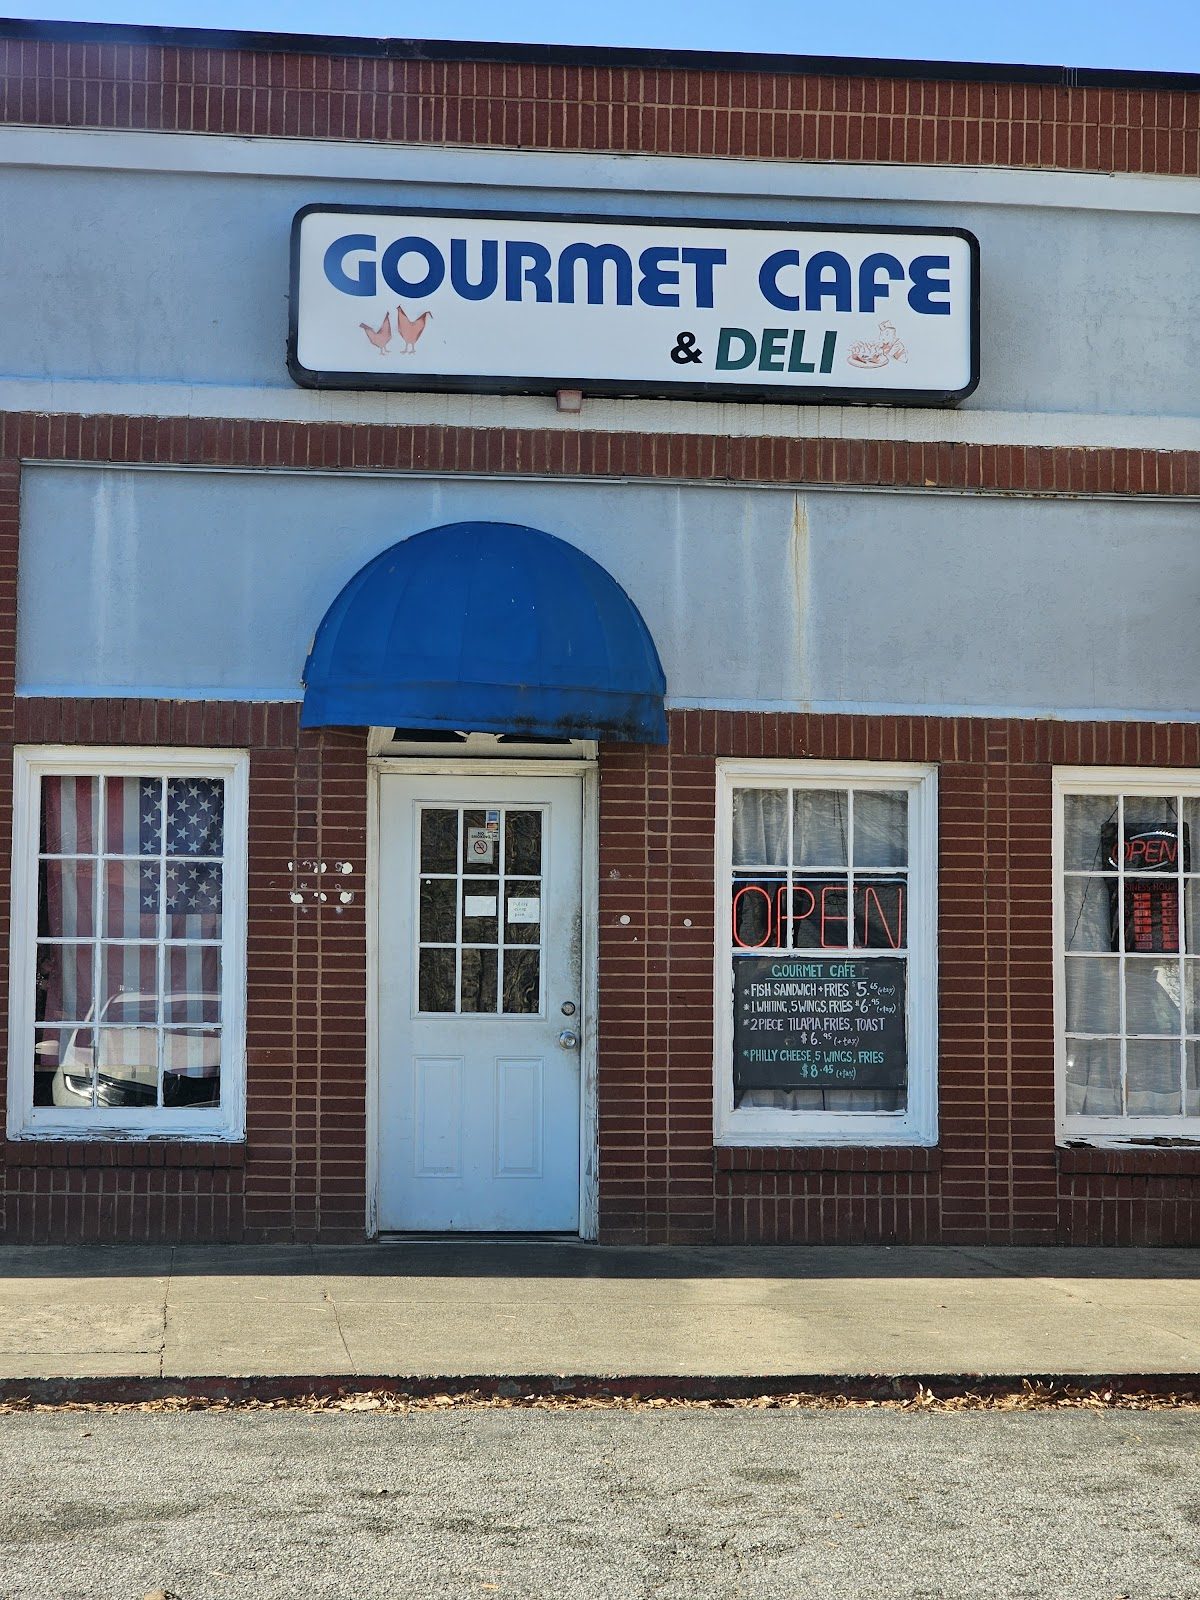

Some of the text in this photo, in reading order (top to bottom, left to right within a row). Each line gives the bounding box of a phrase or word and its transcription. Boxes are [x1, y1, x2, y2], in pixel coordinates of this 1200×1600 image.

[323, 233, 951, 315] GOURMET CAFE
[670, 327, 837, 374] & DELI
[1112, 839, 1178, 863] OPEN
[733, 886, 902, 949] OPEN
[771, 964, 856, 977] GOURMET CAFE
[751, 983, 771, 997] FISH
[773, 983, 816, 997] SANDWICH
[824, 983, 849, 997] FRIES
[829, 1000, 853, 1013] FRIES
[758, 1018, 784, 1031] PIECE
[855, 1017, 885, 1031] TOAST
[750, 1050, 778, 1062] PHILLY
[858, 1051, 884, 1063] FRIES
